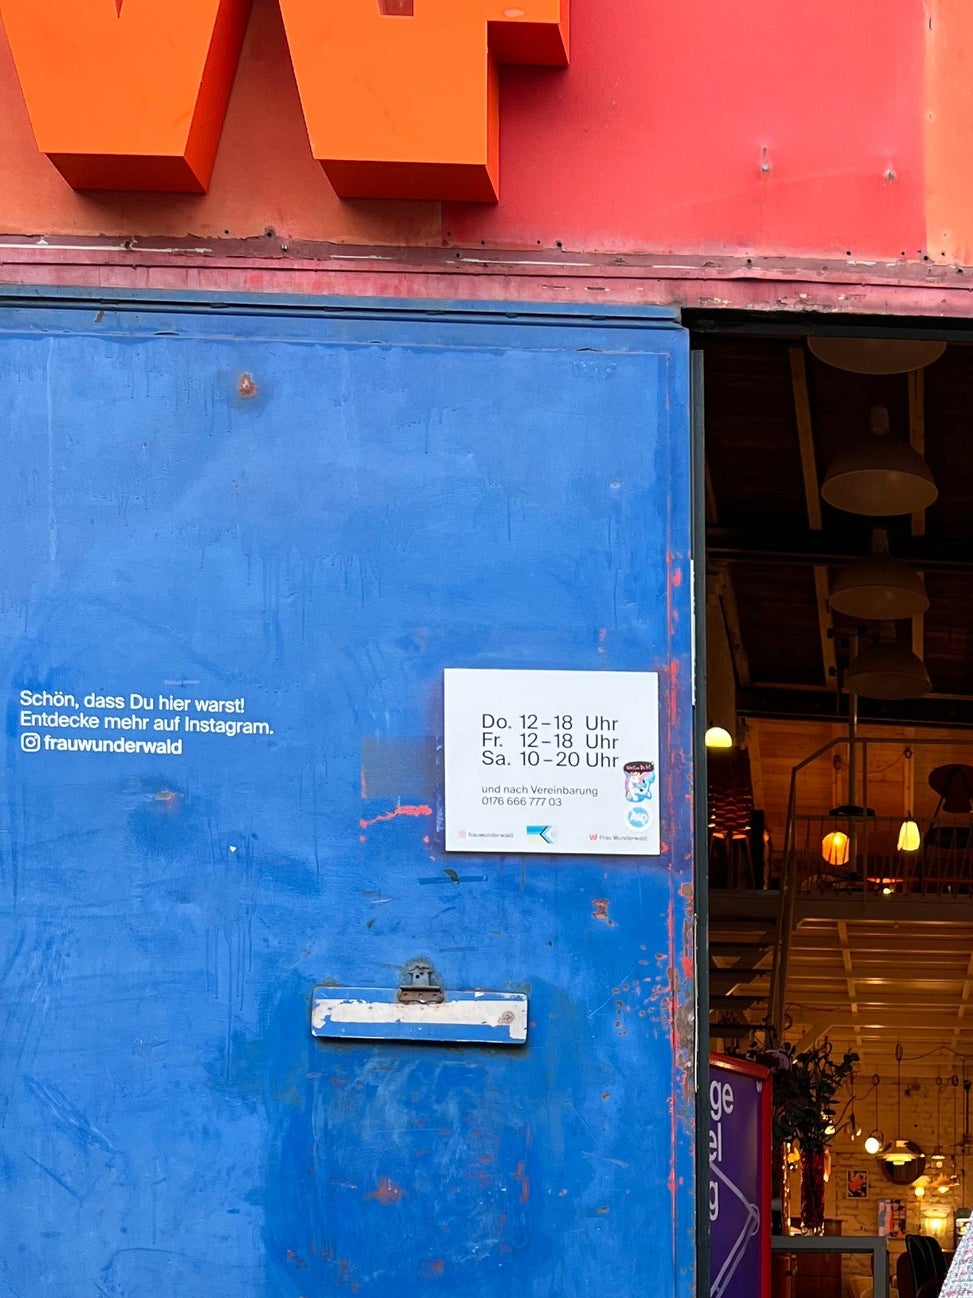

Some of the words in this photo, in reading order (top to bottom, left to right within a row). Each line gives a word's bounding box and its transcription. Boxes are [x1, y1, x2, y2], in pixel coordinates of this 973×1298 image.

[20, 690, 79, 710] Schön,
[84, 692, 125, 709] dass
[130, 693, 154, 710] Du
[159, 694, 191, 711] hier
[195, 697, 245, 713] warst!
[20, 710, 99, 728] Entdecke
[104, 714, 149, 730] mehr
[153, 716, 181, 731] auf
[184, 716, 274, 737] Instagram.
[482, 713, 512, 729] Do.
[586, 715, 619, 731] Uhr
[43, 734, 183, 755] frauwunderwald
[482, 731, 503, 747] Fr.
[586, 733, 619, 749] Uhr
[481, 750, 511, 766] Sa.
[586, 752, 619, 767] Uhr
[481, 785, 501, 794] und
[503, 785, 528, 794] nach
[530, 785, 598, 797] Vereinbarung
[481, 796, 504, 806] 0176
[506, 796, 527, 806] 666
[529, 797, 546, 806] 777
[548, 797, 563, 807] 03
